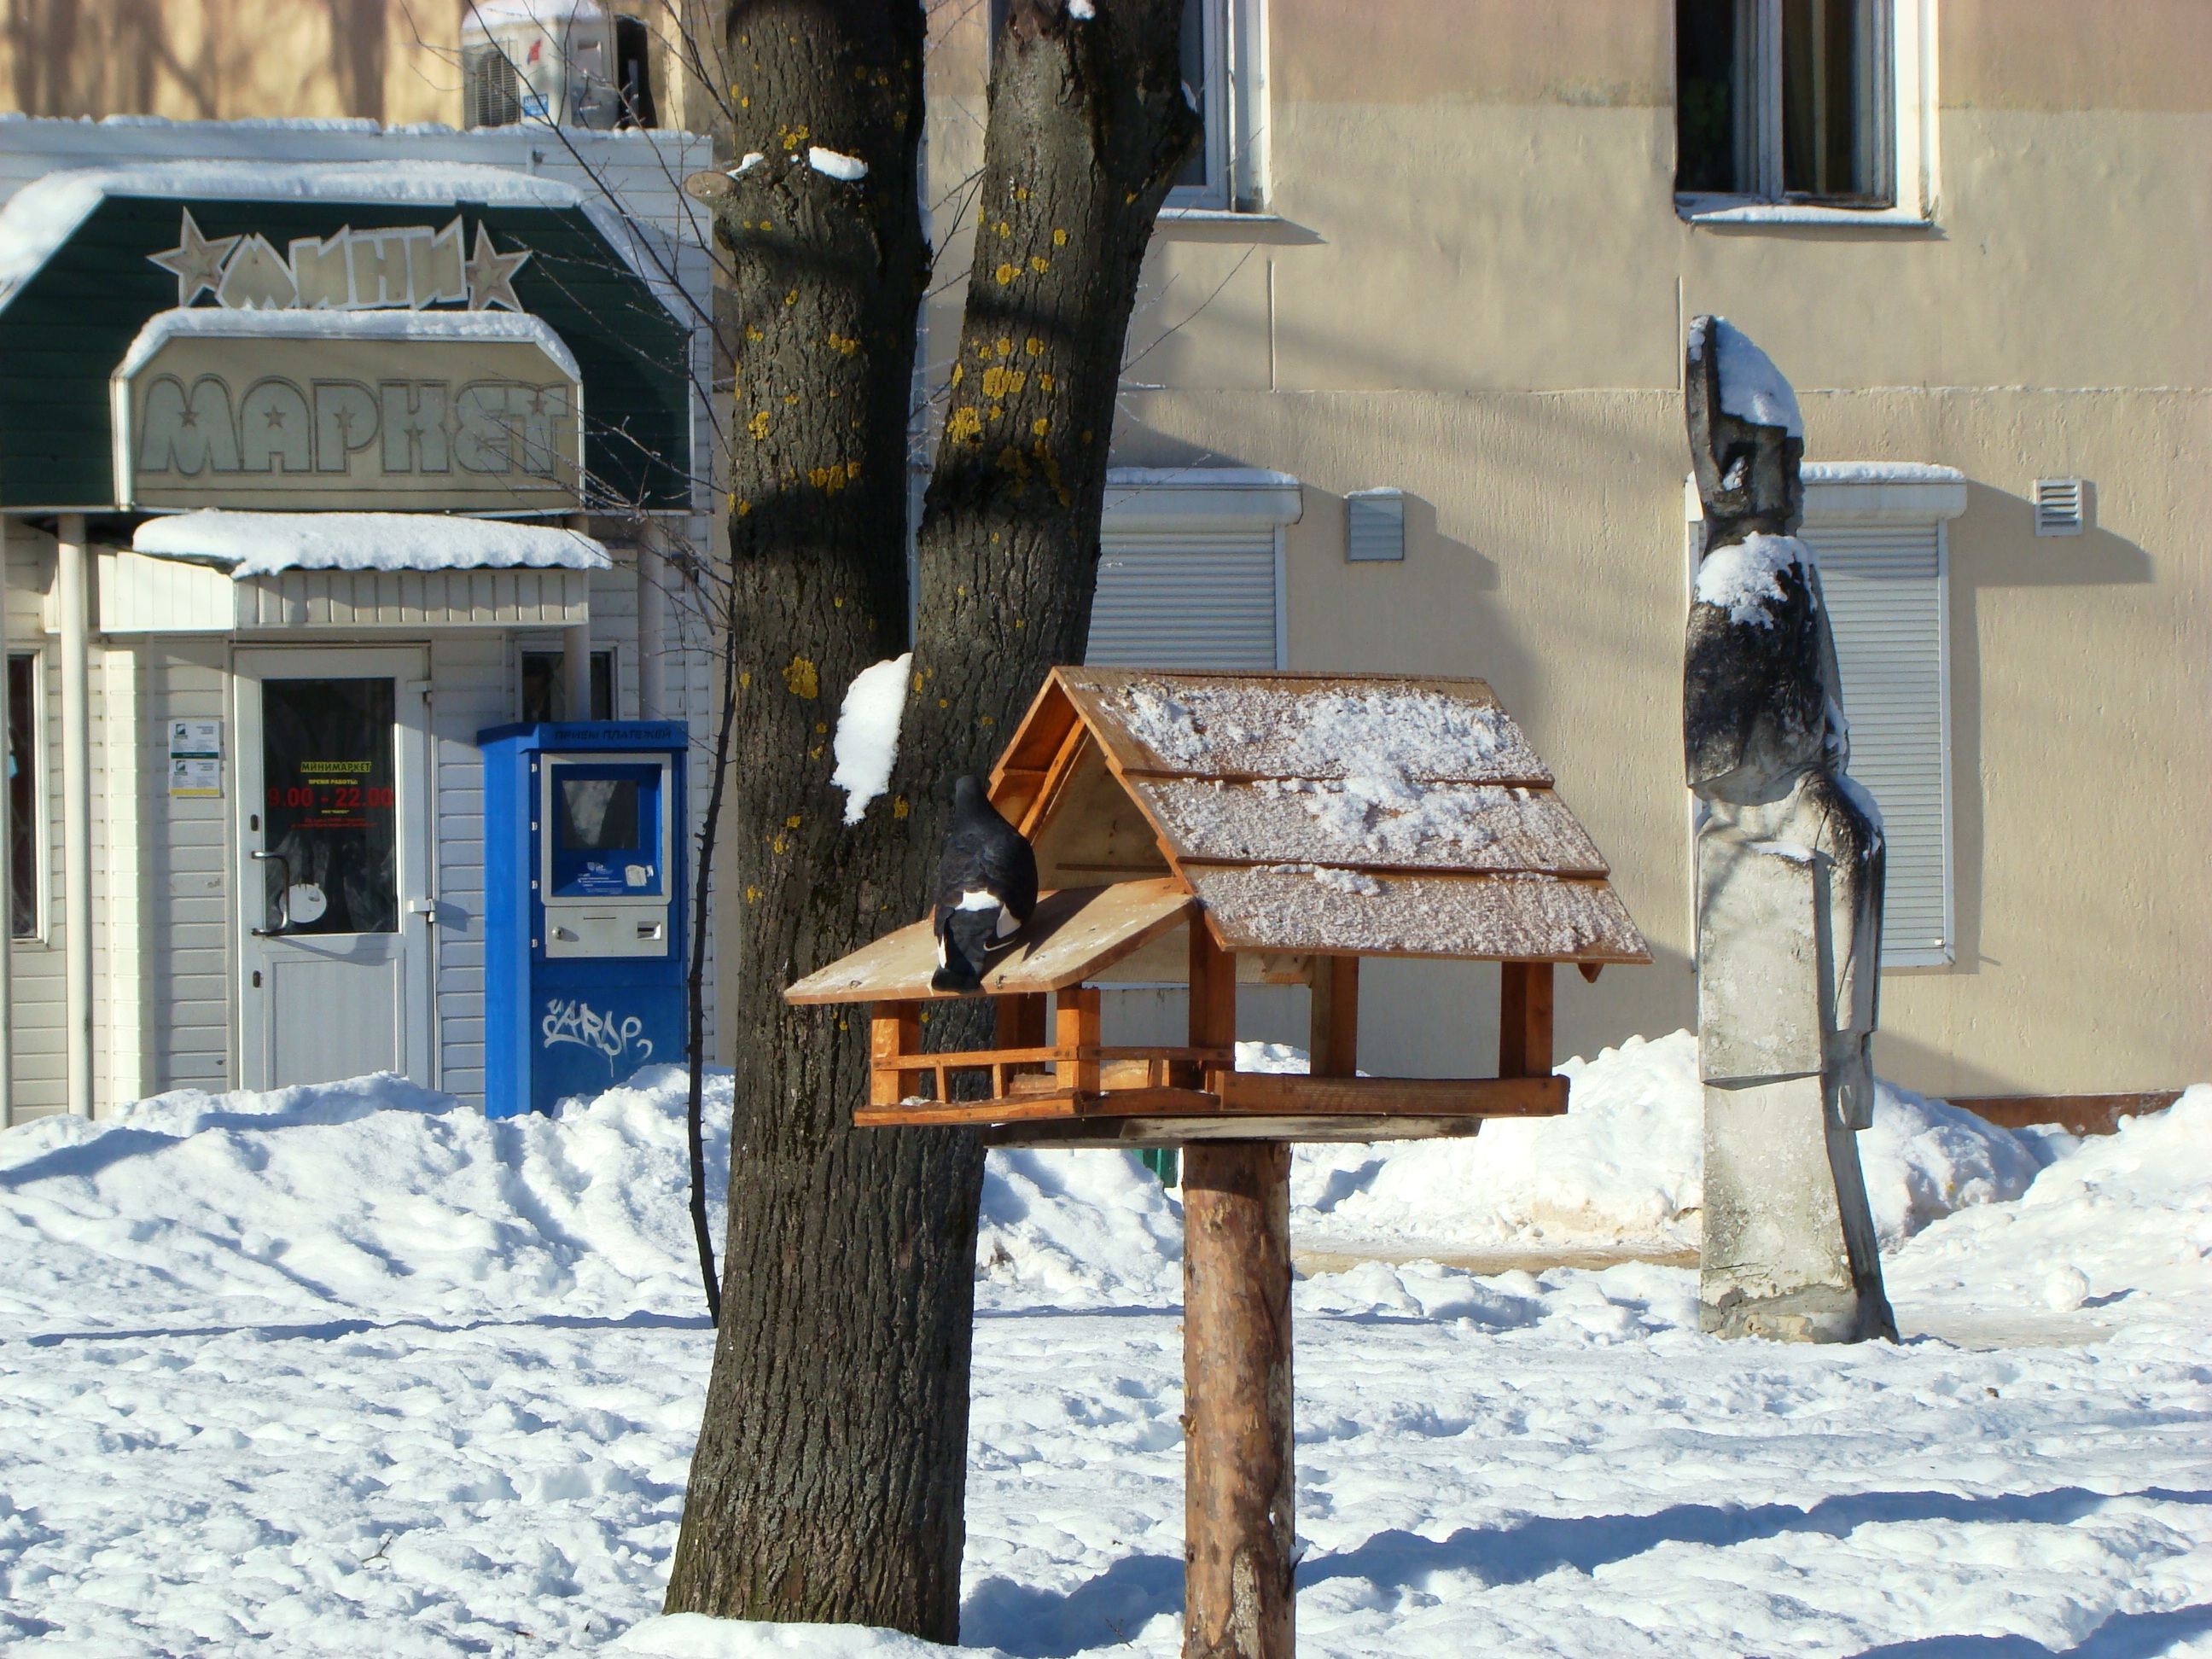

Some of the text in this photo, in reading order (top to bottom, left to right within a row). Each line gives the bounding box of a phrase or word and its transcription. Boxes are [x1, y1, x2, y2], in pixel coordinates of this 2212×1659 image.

[216, 215, 469, 310] МИНИ
[137, 372, 570, 476] МАРКЕТ
[602, 728, 672, 740] ПЛАТЕЖЕЙ
[300, 761, 371, 773] МИНИМАРКЕТ
[268, 787, 313, 807] 9.00
[335, 787, 394, 807] 22.00
